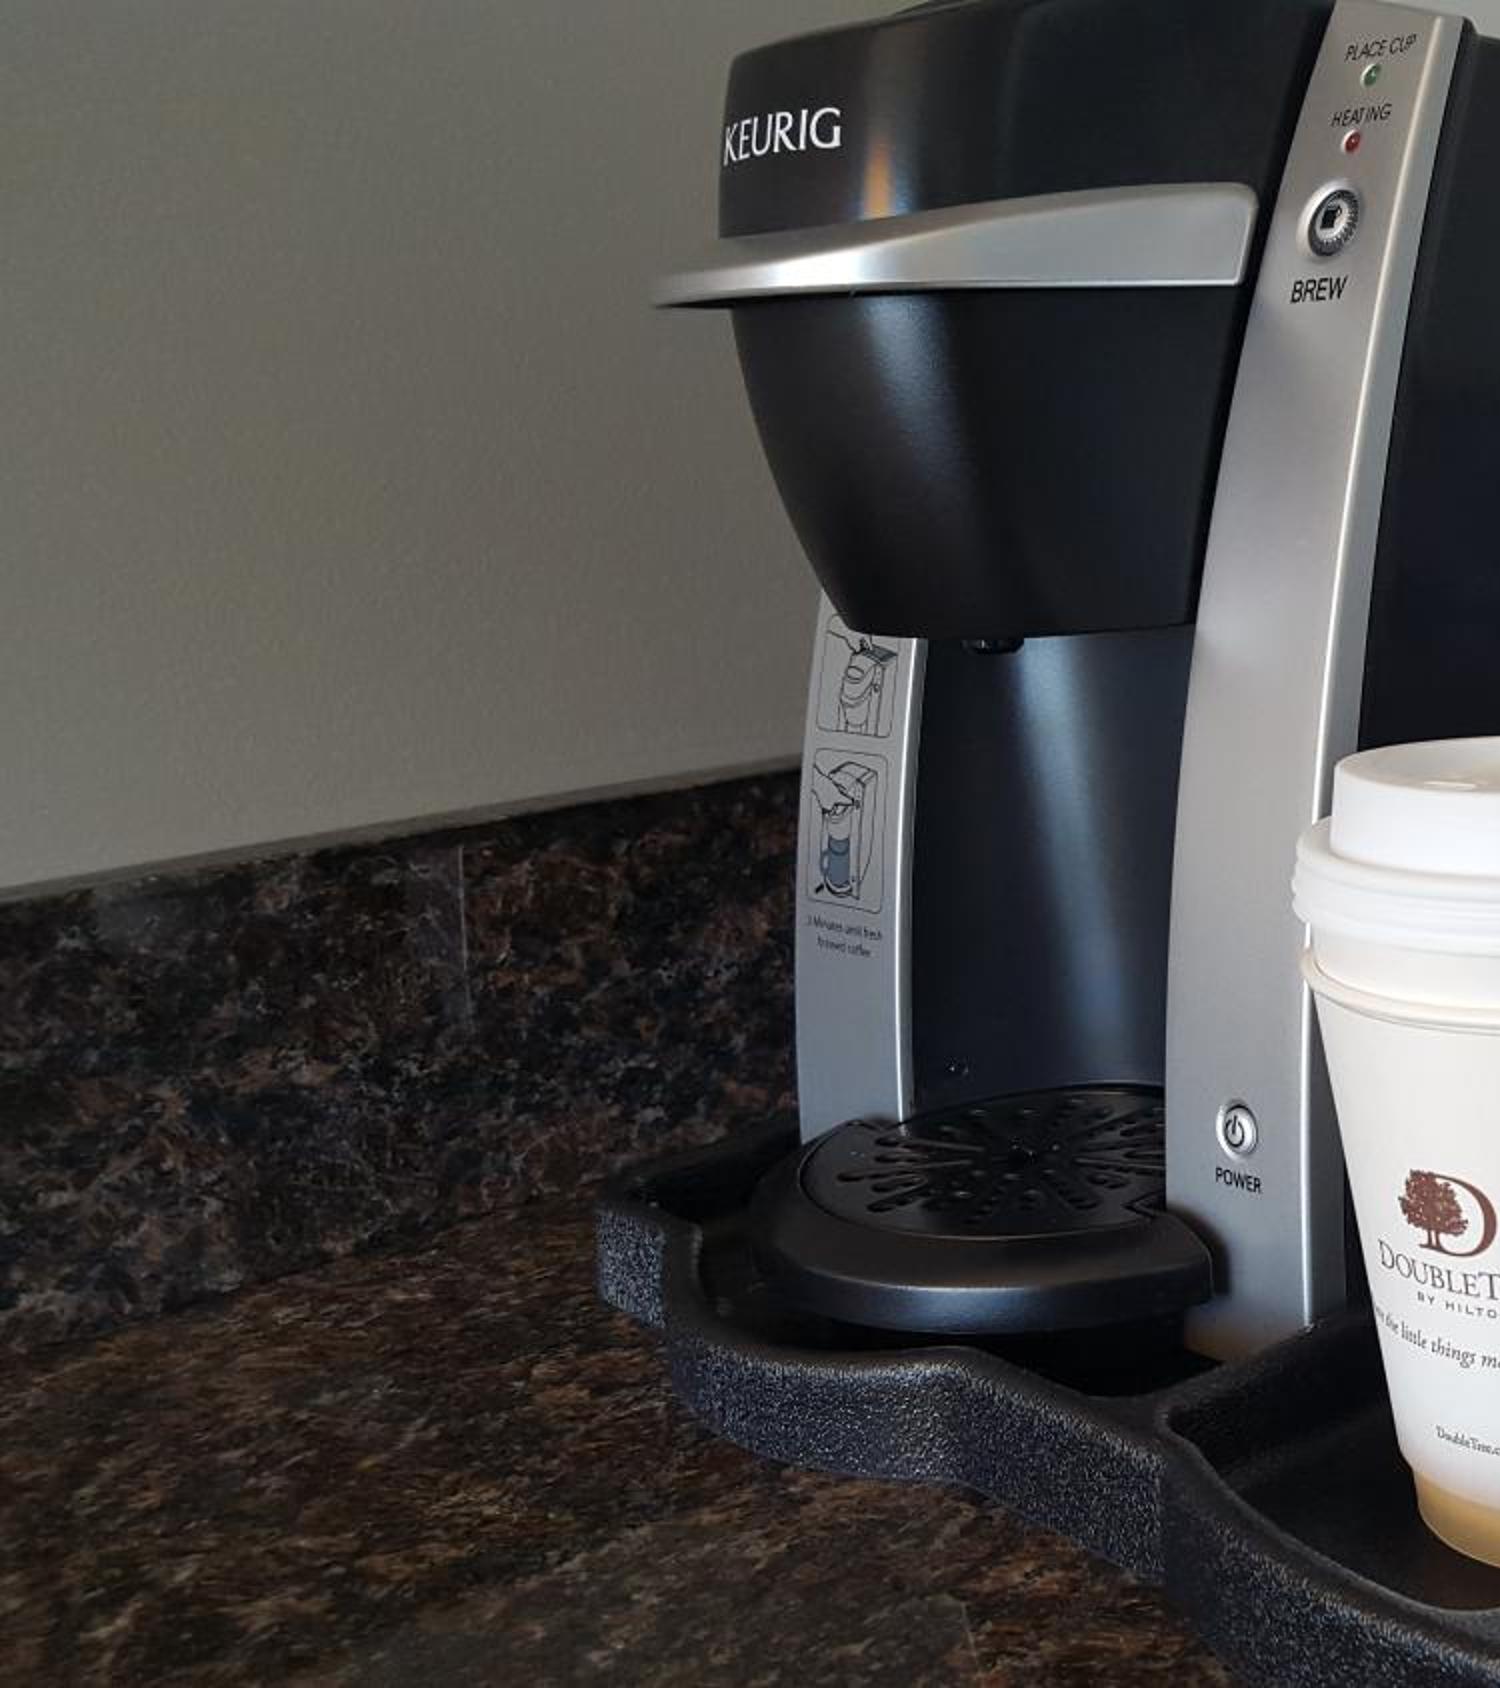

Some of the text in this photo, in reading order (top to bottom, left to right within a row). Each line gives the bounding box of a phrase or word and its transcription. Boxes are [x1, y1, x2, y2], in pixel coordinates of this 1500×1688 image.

[1344, 34, 1417, 62] PLACE CUP
[1330, 103, 1392, 127] HEATING
[723, 106, 842, 166] KEURIG
[1290, 275, 1348, 303] BREW
[1215, 1167, 1263, 1194] POWER
[1417, 1291, 1436, 1305] BY
[1401, 1320, 1428, 1349] little
[1431, 1336, 1476, 1369] things
